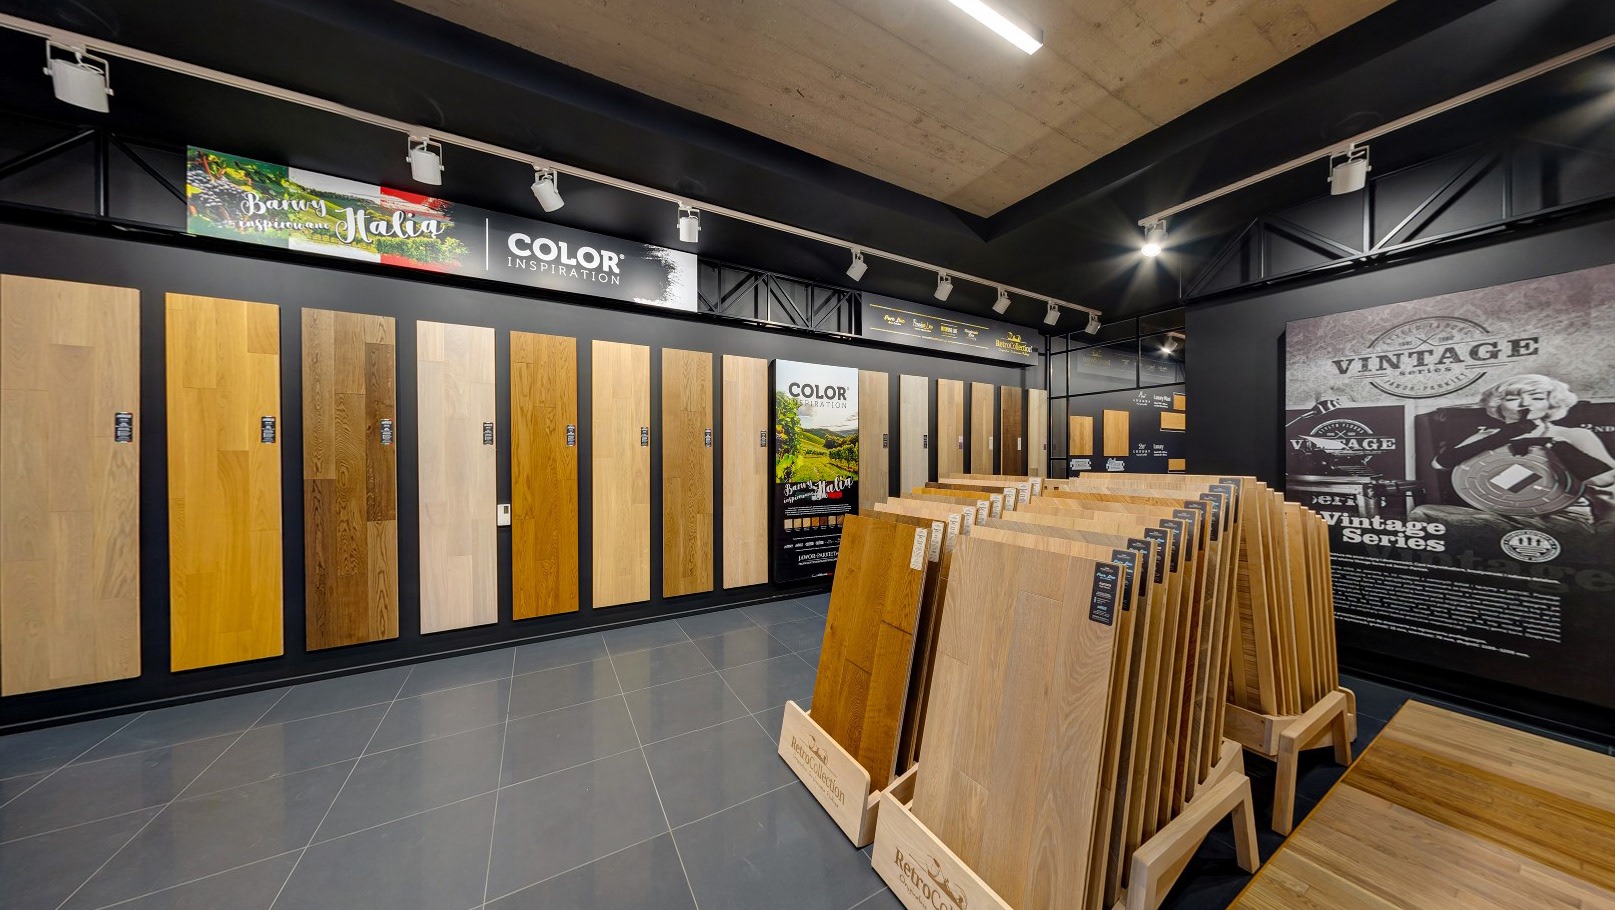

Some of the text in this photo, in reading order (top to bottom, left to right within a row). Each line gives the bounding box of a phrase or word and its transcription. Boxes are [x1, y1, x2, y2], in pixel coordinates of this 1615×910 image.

[241, 192, 327, 217] Barwy
[507, 257, 620, 285] INSPIRATION
[1332, 336, 1539, 375] VINTAGE
[1399, 366, 1452, 376] series
[1320, 511, 1446, 537] Vintage
[1342, 528, 1446, 552] Series
[791, 736, 845, 806] RetroCollection
